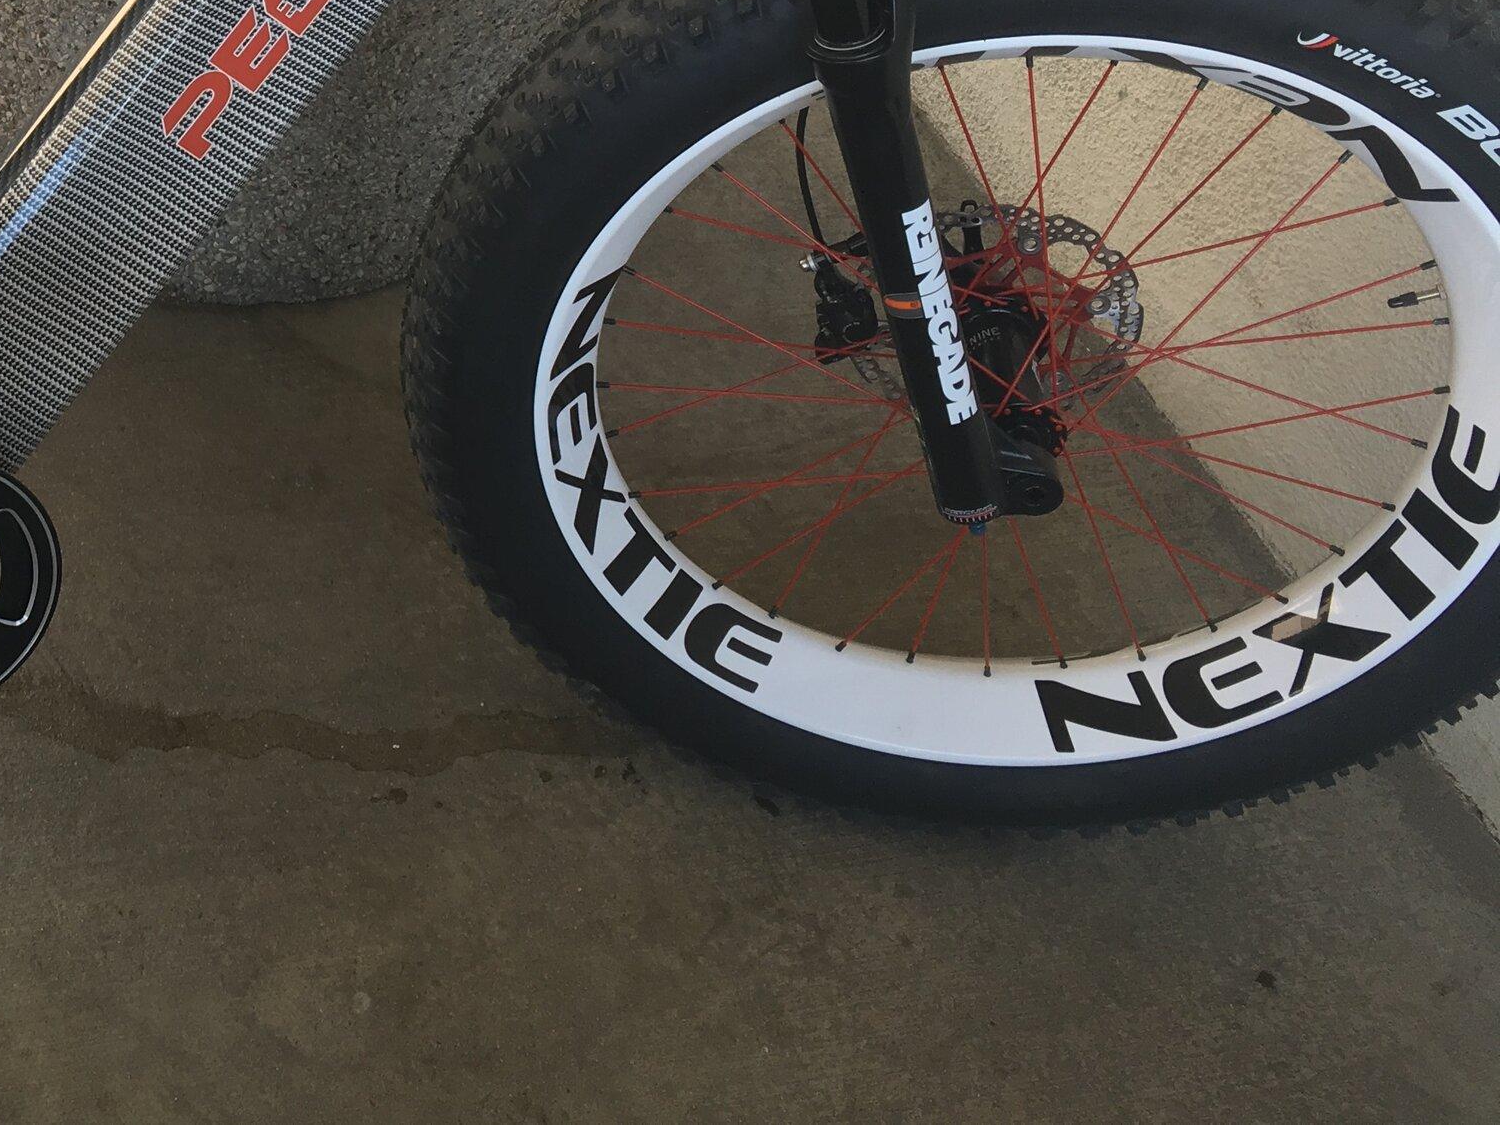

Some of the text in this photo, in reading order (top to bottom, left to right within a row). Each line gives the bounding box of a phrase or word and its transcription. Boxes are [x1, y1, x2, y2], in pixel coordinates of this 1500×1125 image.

[1333, 42, 1436, 100] vittoria
[901, 198, 979, 426] RENEGADE
[547, 265, 783, 694] NEXTIE
[1033, 403, 1500, 753] NEXTIE
